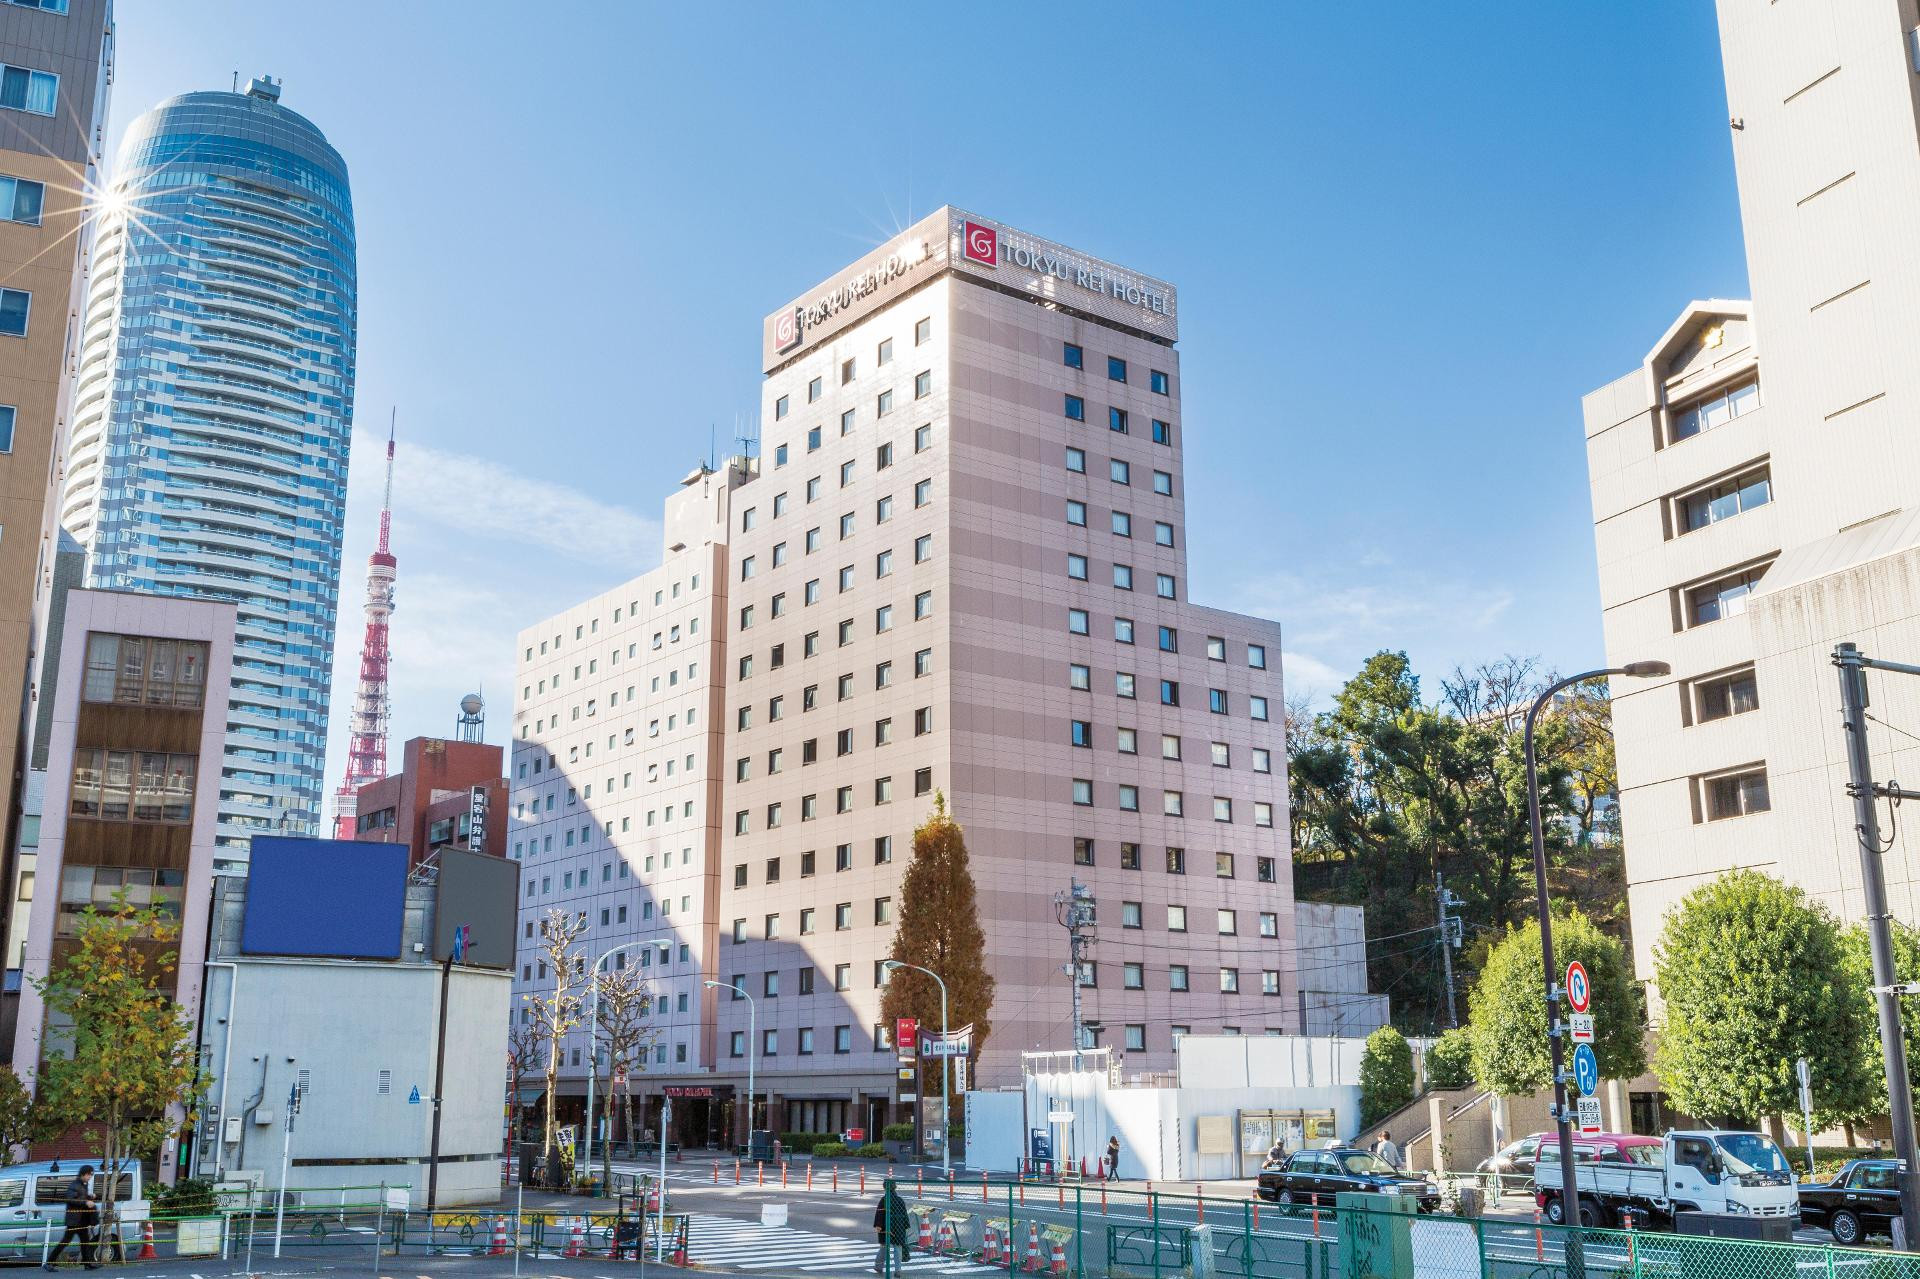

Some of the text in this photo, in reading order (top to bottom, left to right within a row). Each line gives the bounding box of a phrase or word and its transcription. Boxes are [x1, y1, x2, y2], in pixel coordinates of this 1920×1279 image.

[1003, 243, 1172, 316] TOKYU REI HOTEL
[797, 285, 843, 329] TOKYU
[1579, 1058, 1588, 1090] P
